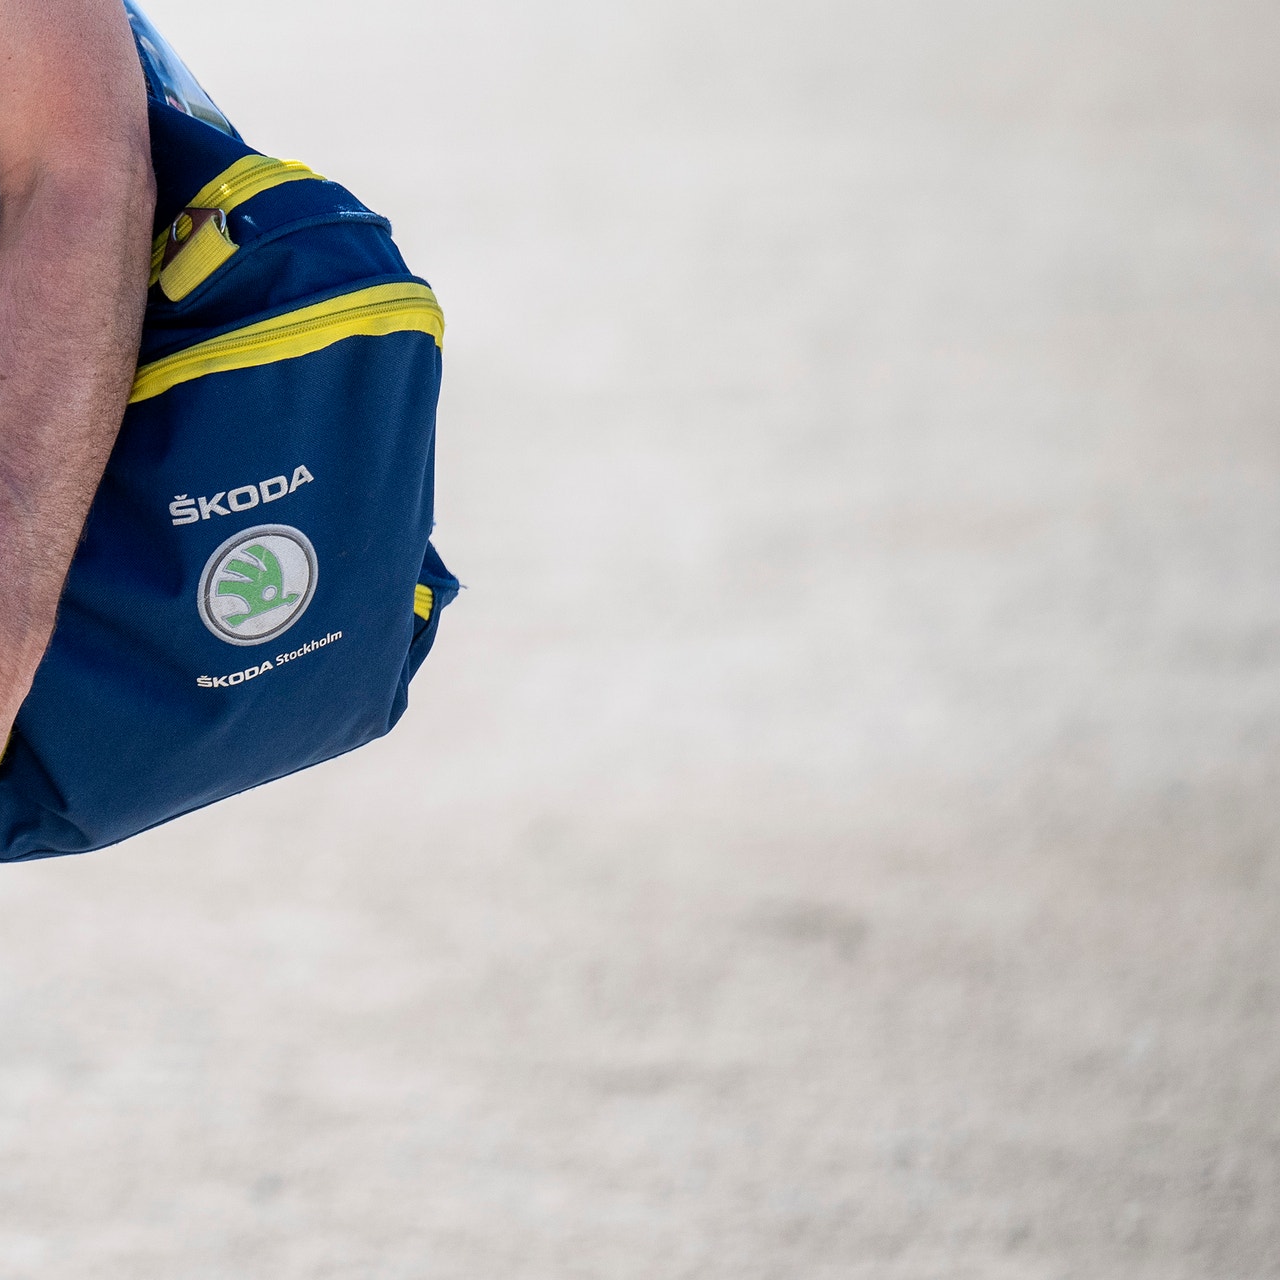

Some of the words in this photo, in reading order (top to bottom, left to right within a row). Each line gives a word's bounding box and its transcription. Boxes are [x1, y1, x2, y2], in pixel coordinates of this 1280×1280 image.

[168, 464, 314, 526] ŠKODA
[196, 660, 274, 688] ŠKODA
[275, 630, 343, 666] Stockholm
